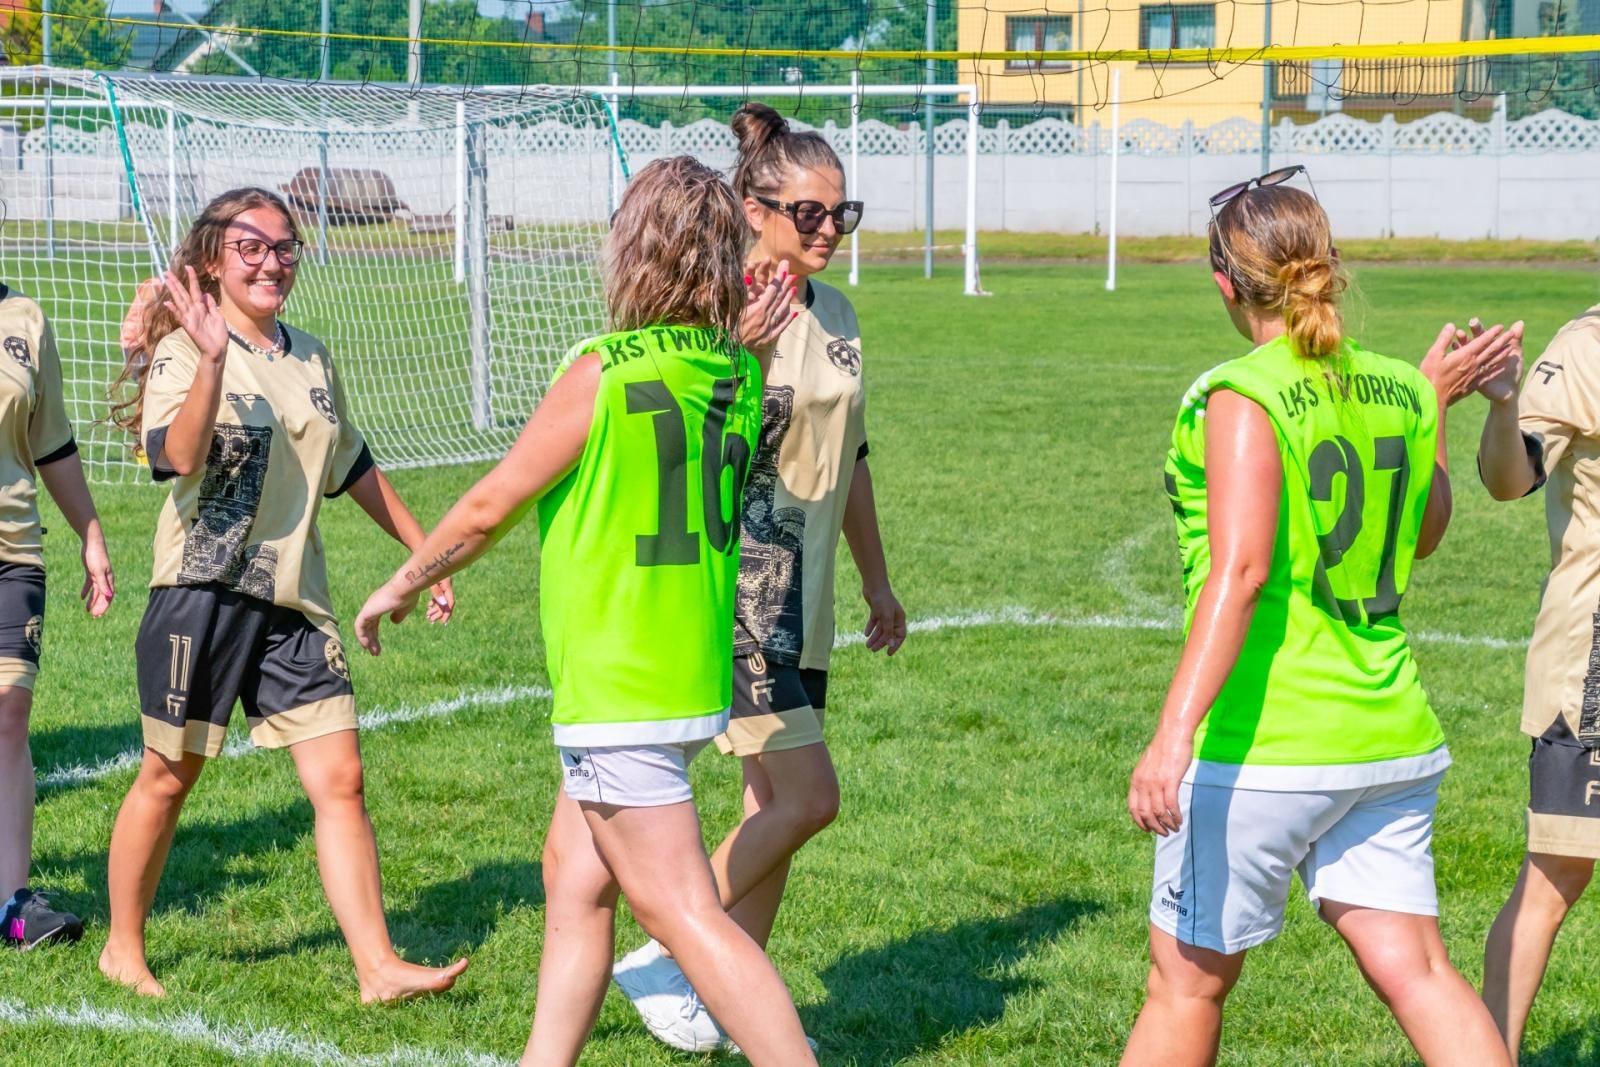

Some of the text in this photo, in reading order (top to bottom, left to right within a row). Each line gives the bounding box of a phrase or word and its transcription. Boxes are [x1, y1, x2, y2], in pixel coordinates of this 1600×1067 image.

[651, 328, 737, 359] TWOR
[1278, 377, 1319, 418] LKS
[625, 378, 750, 566] 16
[169, 634, 192, 692] 11
[1161, 897, 1188, 917] erima
